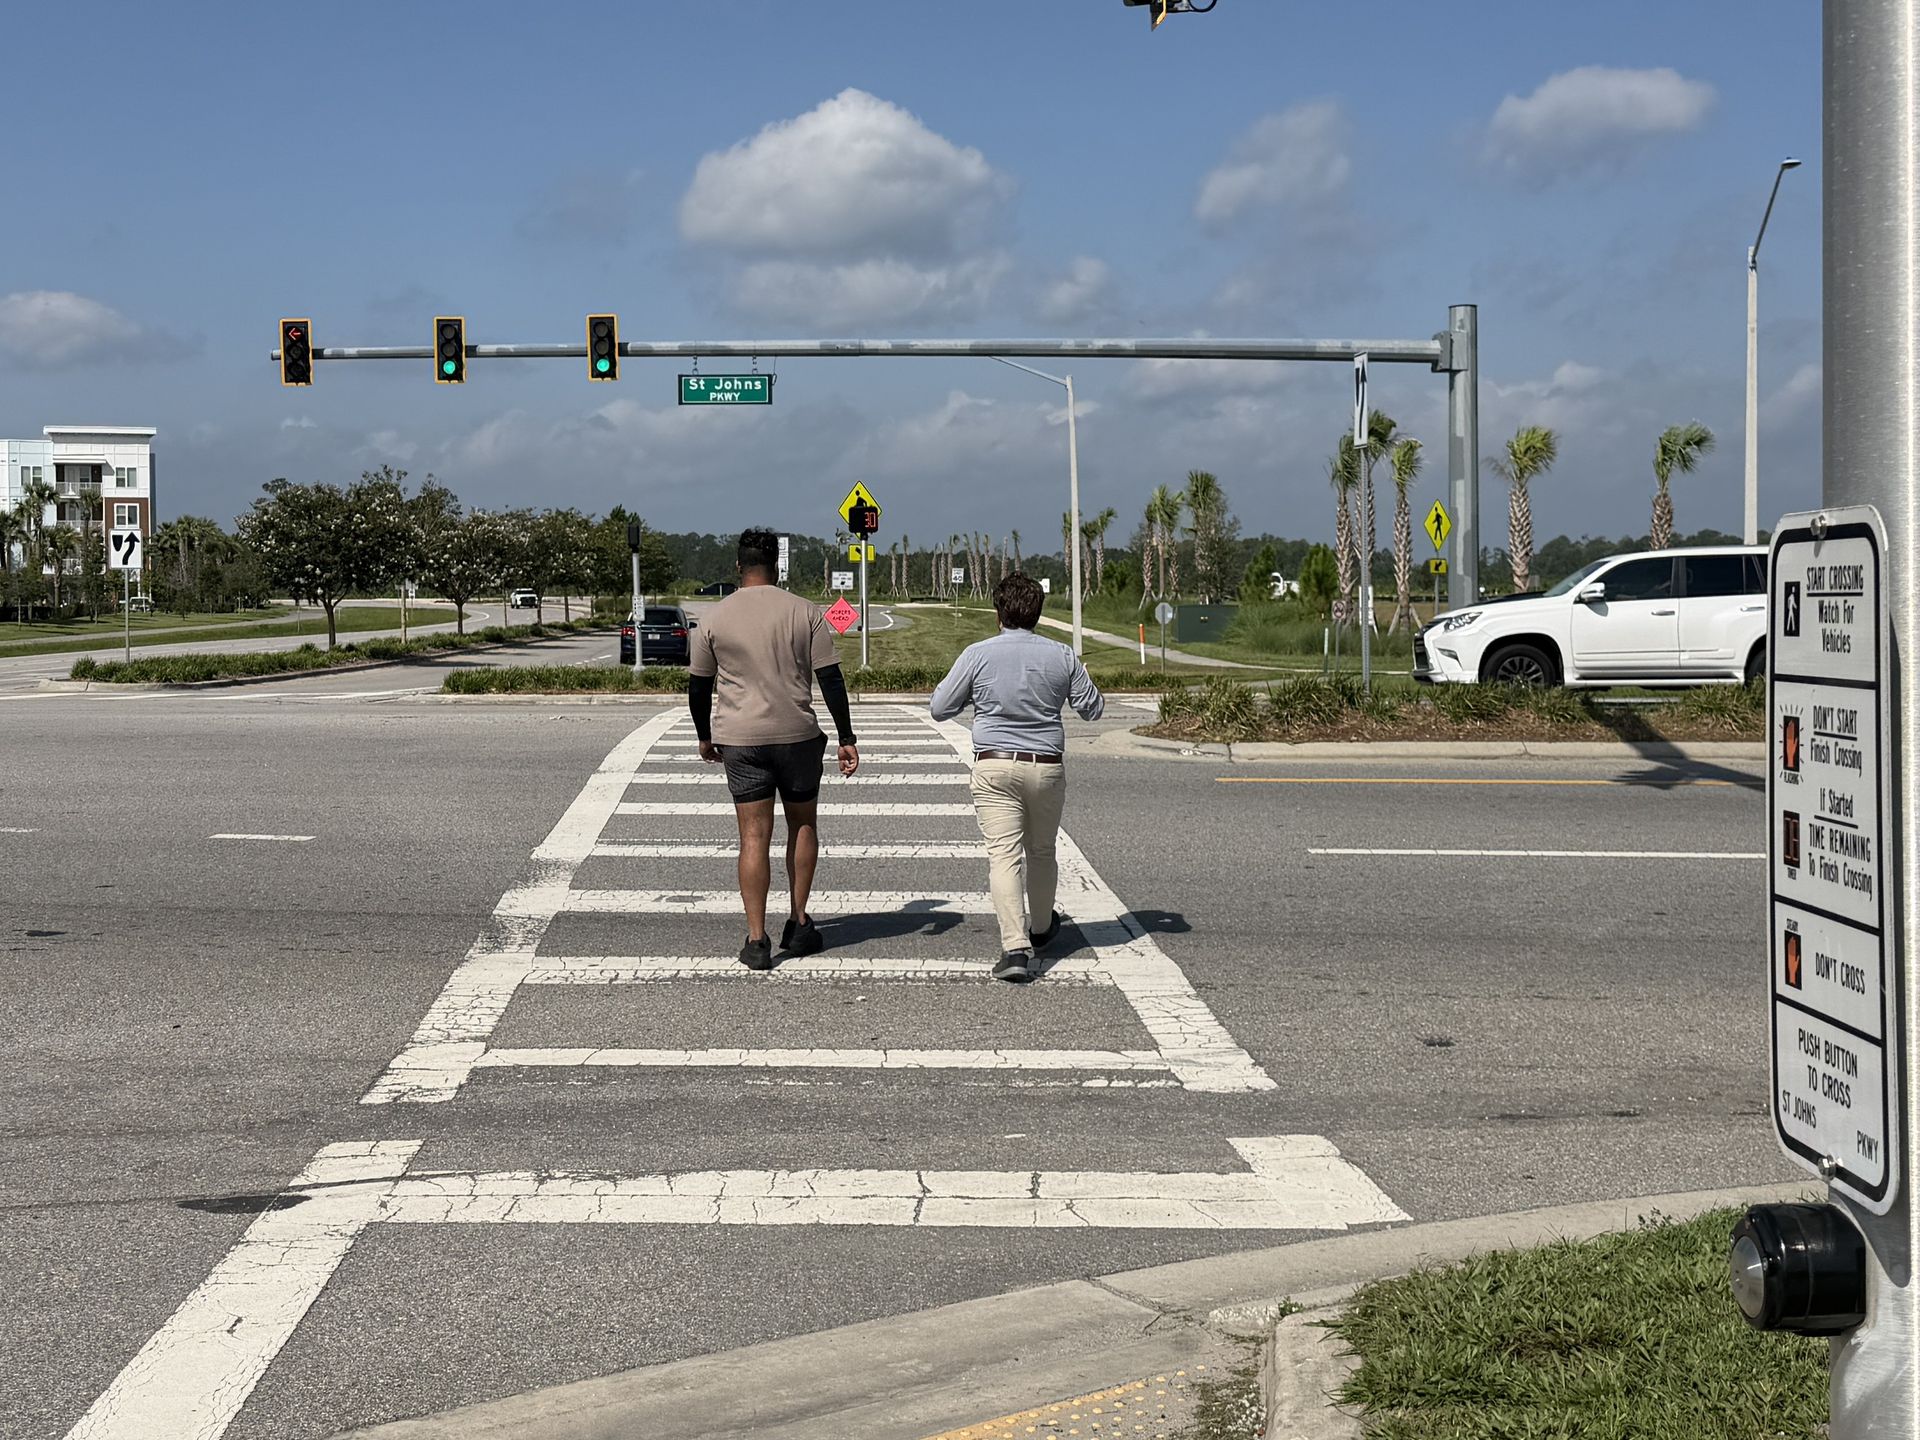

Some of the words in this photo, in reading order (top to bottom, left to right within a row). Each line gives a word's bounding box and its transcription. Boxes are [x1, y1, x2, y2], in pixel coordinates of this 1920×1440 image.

[689, 378, 705, 390] St
[715, 378, 762, 390] Johns
[709, 392, 741, 401] PKWY
[864, 512, 876, 527] 30
[1806, 567, 1825, 591] START
[1828, 565, 1864, 591] CROSSING
[1818, 599, 1840, 624] Watch
[1843, 599, 1855, 624] For
[1822, 627, 1851, 654] Vehicles
[1813, 705, 1834, 731] DON'T
[1837, 707, 1858, 735] START
[1810, 738, 1830, 765] Finish
[1834, 741, 1862, 778] Crossing
[1820, 787, 1826, 812] If
[1828, 788, 1853, 818] Started
[1808, 822, 1825, 850] TIME
[1829, 828, 1871, 863] REMAINING
[1808, 852, 1815, 876] To
[1819, 855, 1839, 884] Finish
[1843, 862, 1873, 902] Crossing
[1815, 952, 1837, 983] DON'T
[1840, 962, 1865, 995] CROSS
[1798, 1028, 1821, 1060] PUSH
[1824, 1040, 1858, 1079] BUTTON
[1807, 1065, 1818, 1091] TO
[1822, 1072, 1851, 1109] CROSS
[1782, 1089, 1791, 1114] ST
[1793, 1096, 1817, 1129] JOHNS
[1856, 1130, 1879, 1164] PKWY
